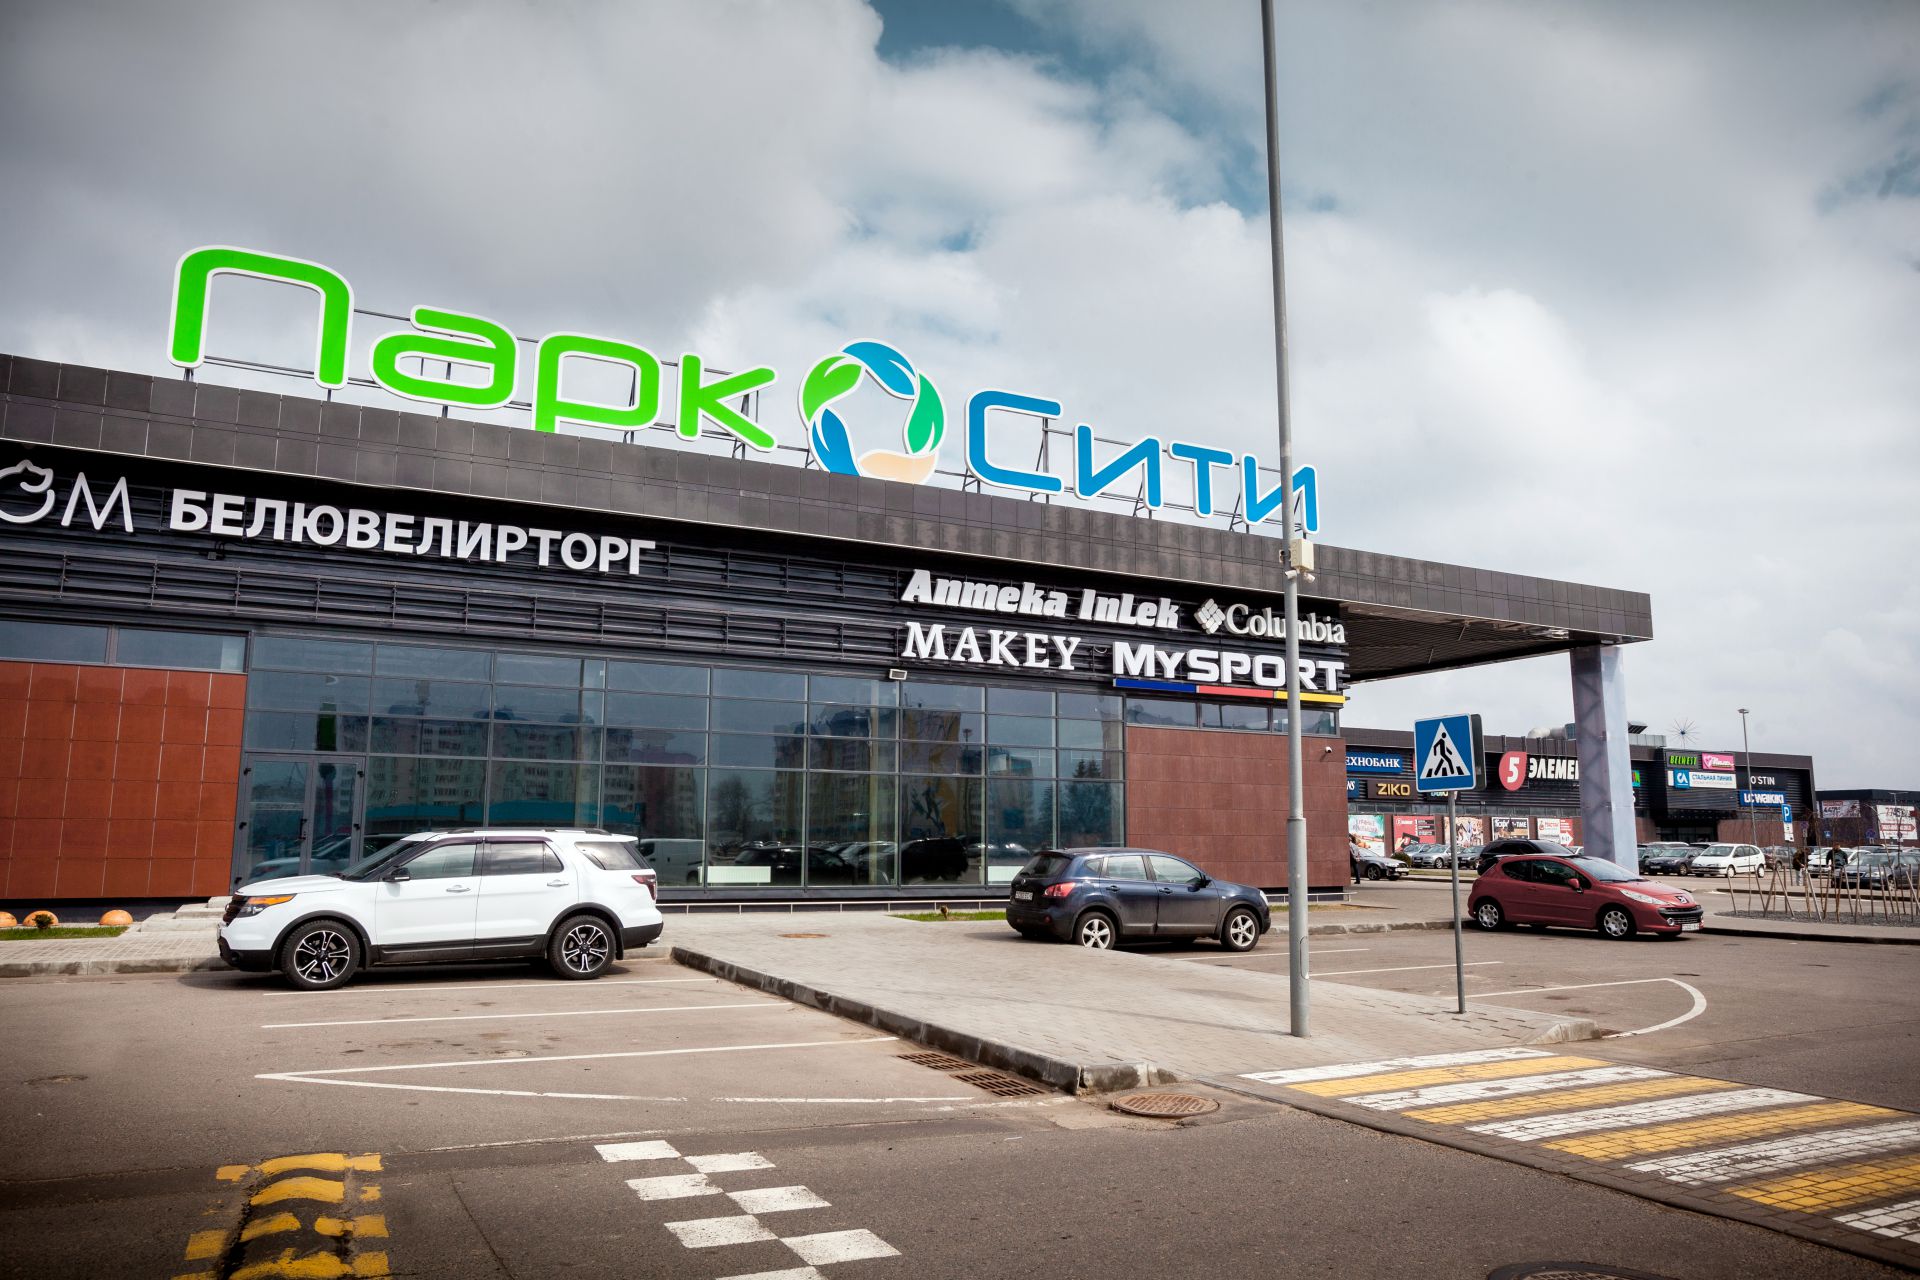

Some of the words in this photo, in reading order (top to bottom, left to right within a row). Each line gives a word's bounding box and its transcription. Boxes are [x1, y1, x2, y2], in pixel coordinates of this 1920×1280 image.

[167, 245, 778, 453] Парк
[965, 389, 1320, 535] Сити
[169, 488, 656, 576] БЕЛЮВЕЛИРТОРГ
[1078, 588, 1180, 630] InLek
[1225, 603, 1346, 644] Columbia
[901, 621, 1082, 671] MAKEY
[1377, 782, 1411, 796] ZIKO
[1507, 756, 1520, 783] 5
[1783, 806, 1790, 822] P
